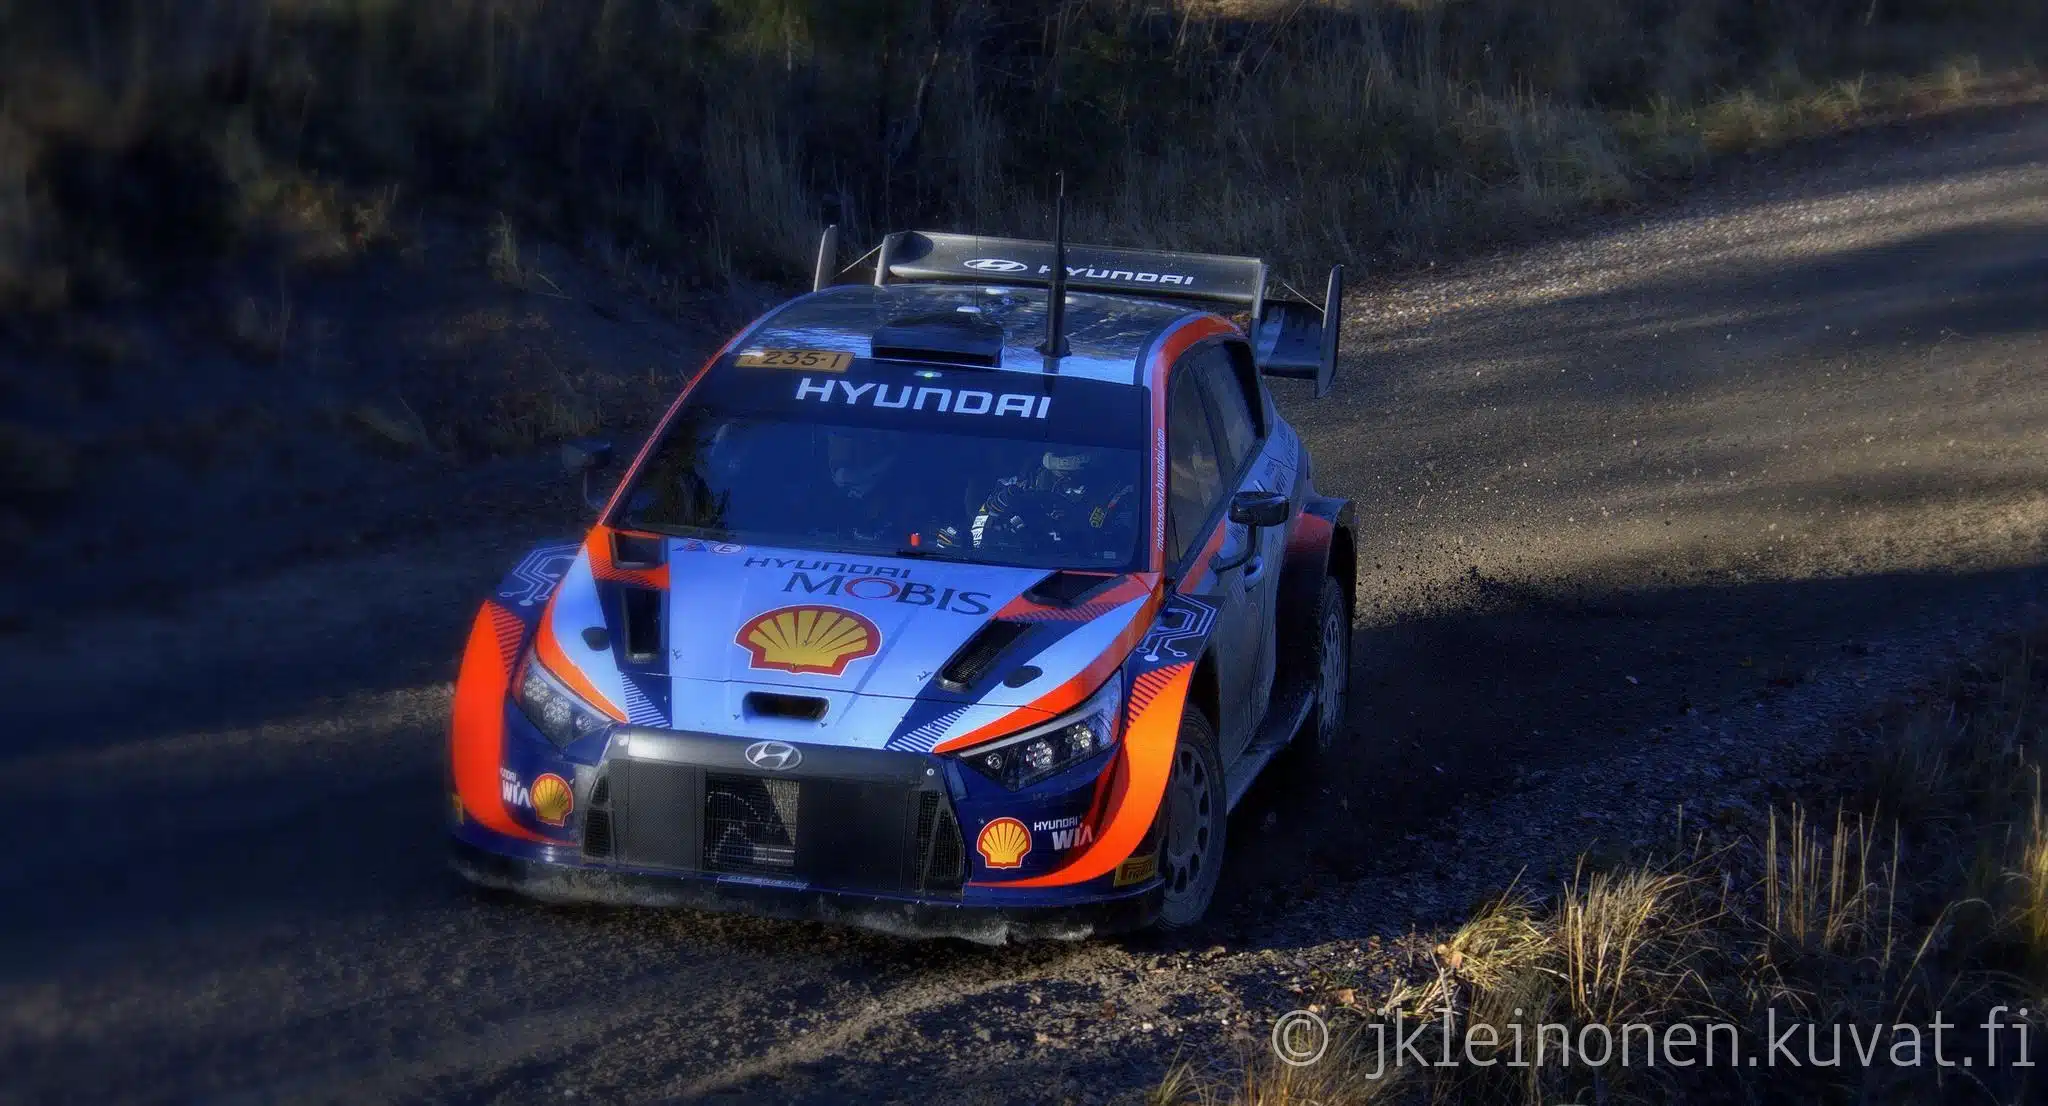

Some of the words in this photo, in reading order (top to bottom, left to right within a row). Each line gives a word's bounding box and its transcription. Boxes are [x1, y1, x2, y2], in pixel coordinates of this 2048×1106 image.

[795, 377, 1052, 419] HYUNDAI
[1155, 428, 1166, 551] motorsport.hyundai.com
[743, 556, 913, 579] HYUNDAI
[781, 571, 993, 616] MOBIS
[502, 779, 532, 808] WIA
[1034, 815, 1078, 832] HYUNDAI
[1052, 822, 1093, 851] WIA
